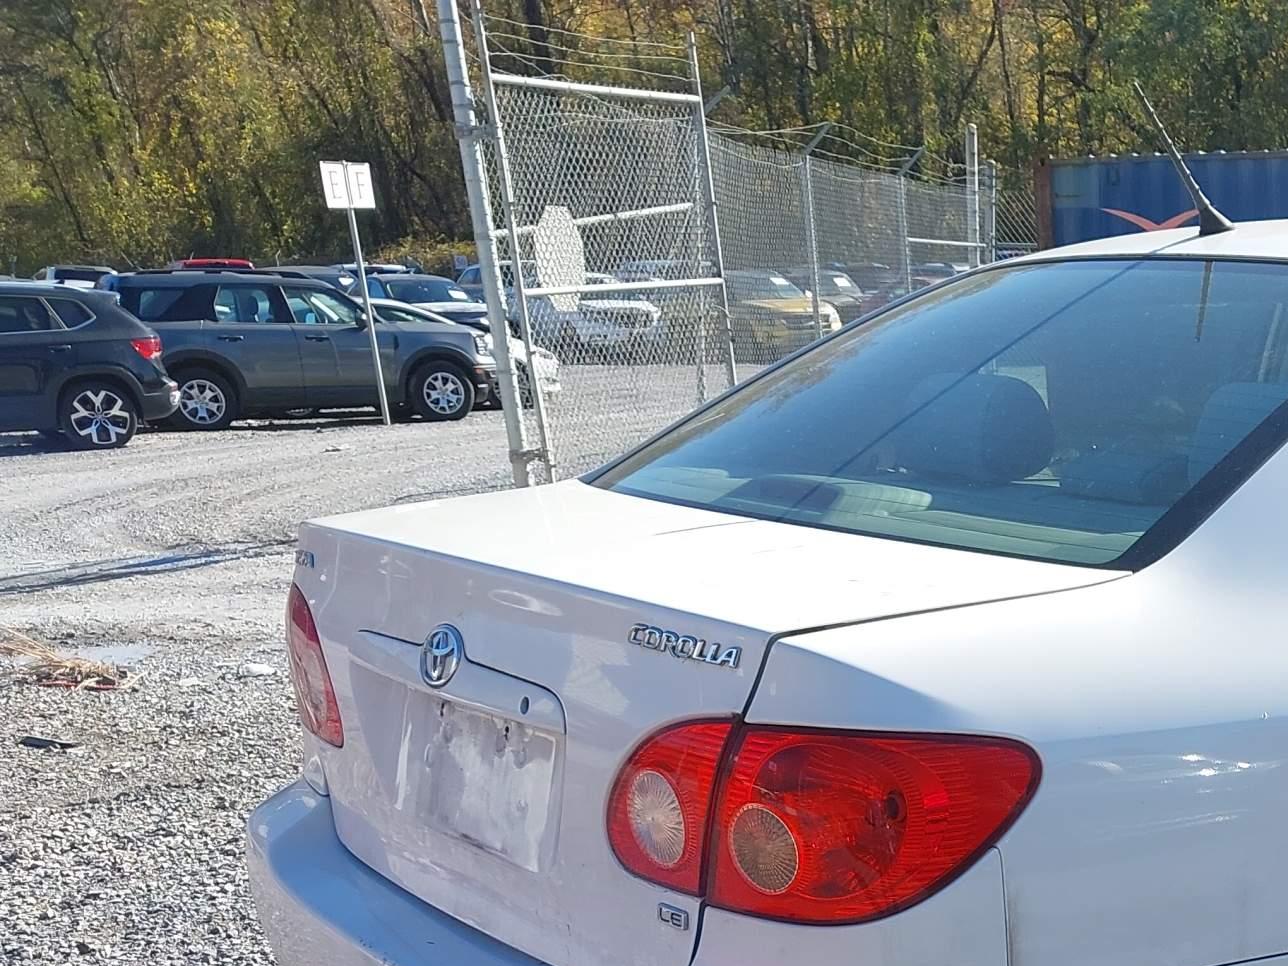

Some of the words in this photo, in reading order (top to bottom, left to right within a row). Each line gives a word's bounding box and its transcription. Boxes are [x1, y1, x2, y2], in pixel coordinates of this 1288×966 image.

[328, 170, 343, 199] E
[355, 171, 366, 199] F
[628, 623, 742, 669] COROLLA
[658, 905, 685, 929] LE
